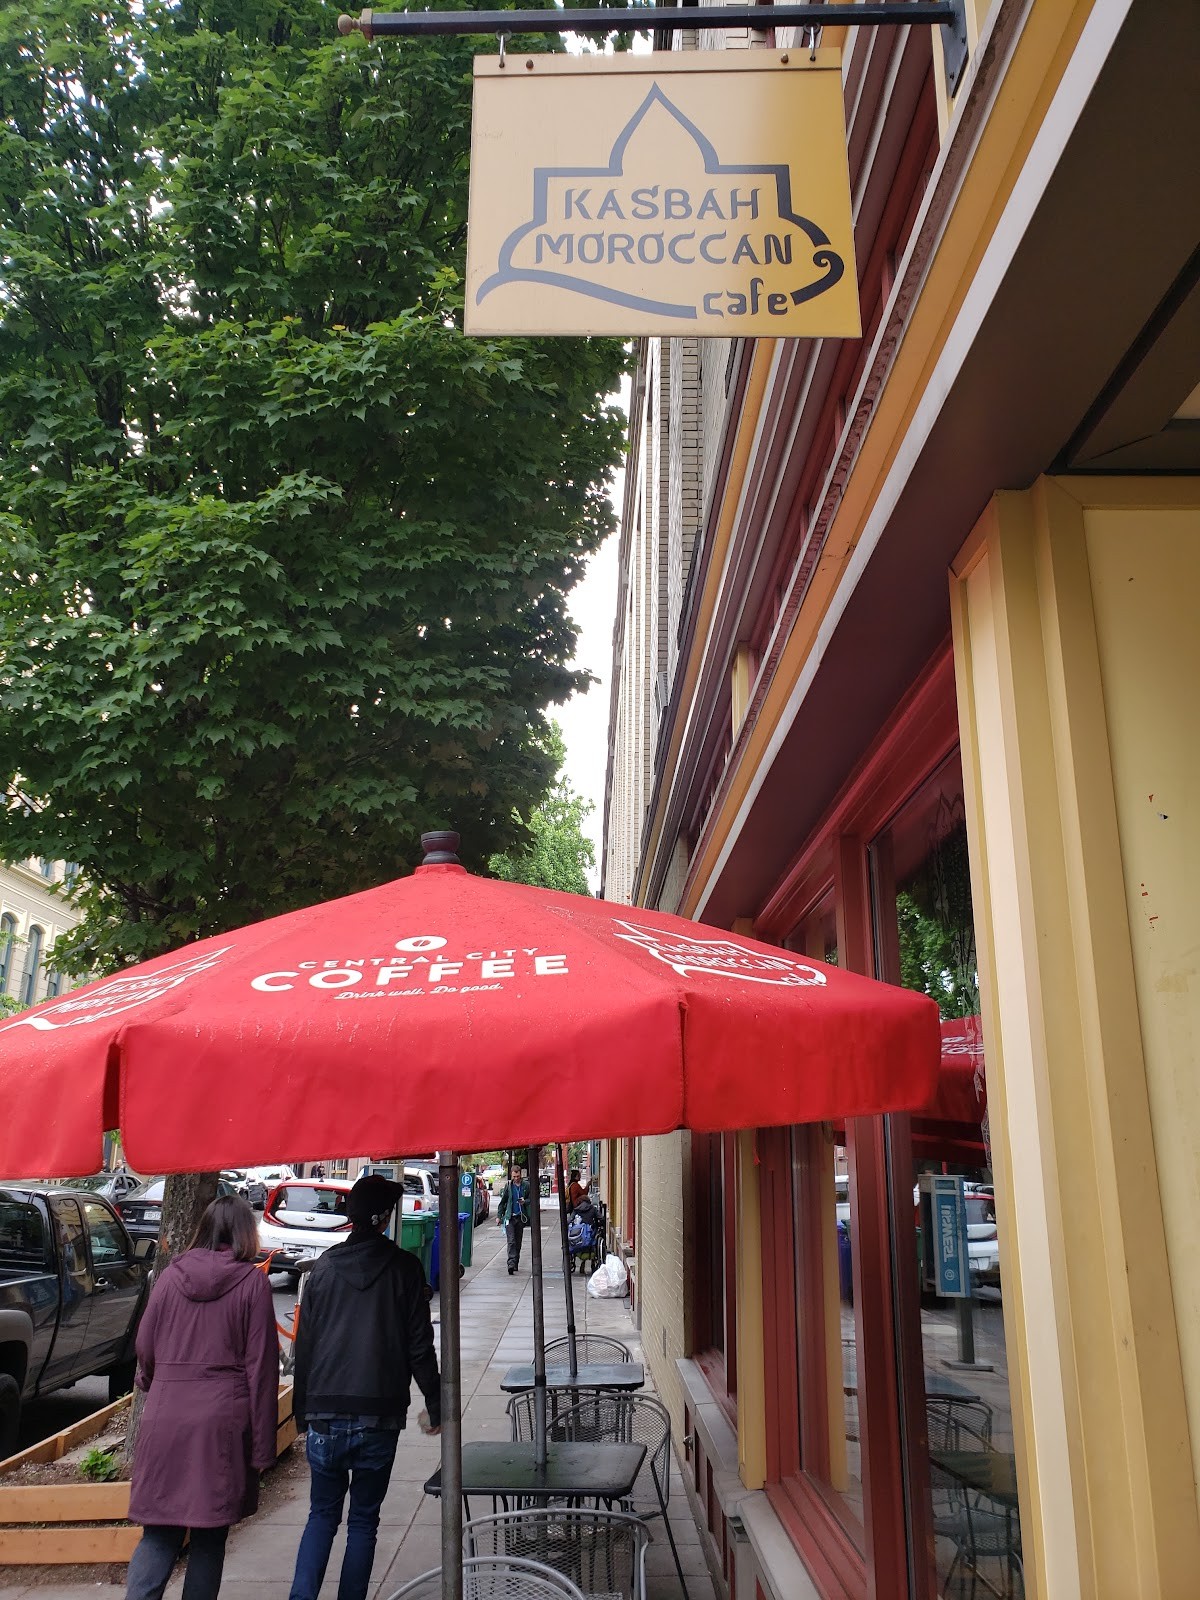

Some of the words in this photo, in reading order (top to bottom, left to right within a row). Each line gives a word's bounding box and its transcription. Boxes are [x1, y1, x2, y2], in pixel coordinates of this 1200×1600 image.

[564, 185, 760, 220] KASBAH
[535, 230, 792, 265] MOROCCAN
[703, 277, 789, 319] cafe
[250, 954, 569, 992] COFFEE
[298, 955, 449, 969] CENTRAL
[466, 947, 538, 960] CITY
[333, 991, 386, 1000] Drink
[430, 985, 458, 994] Do
[460, 983, 504, 993] good.
